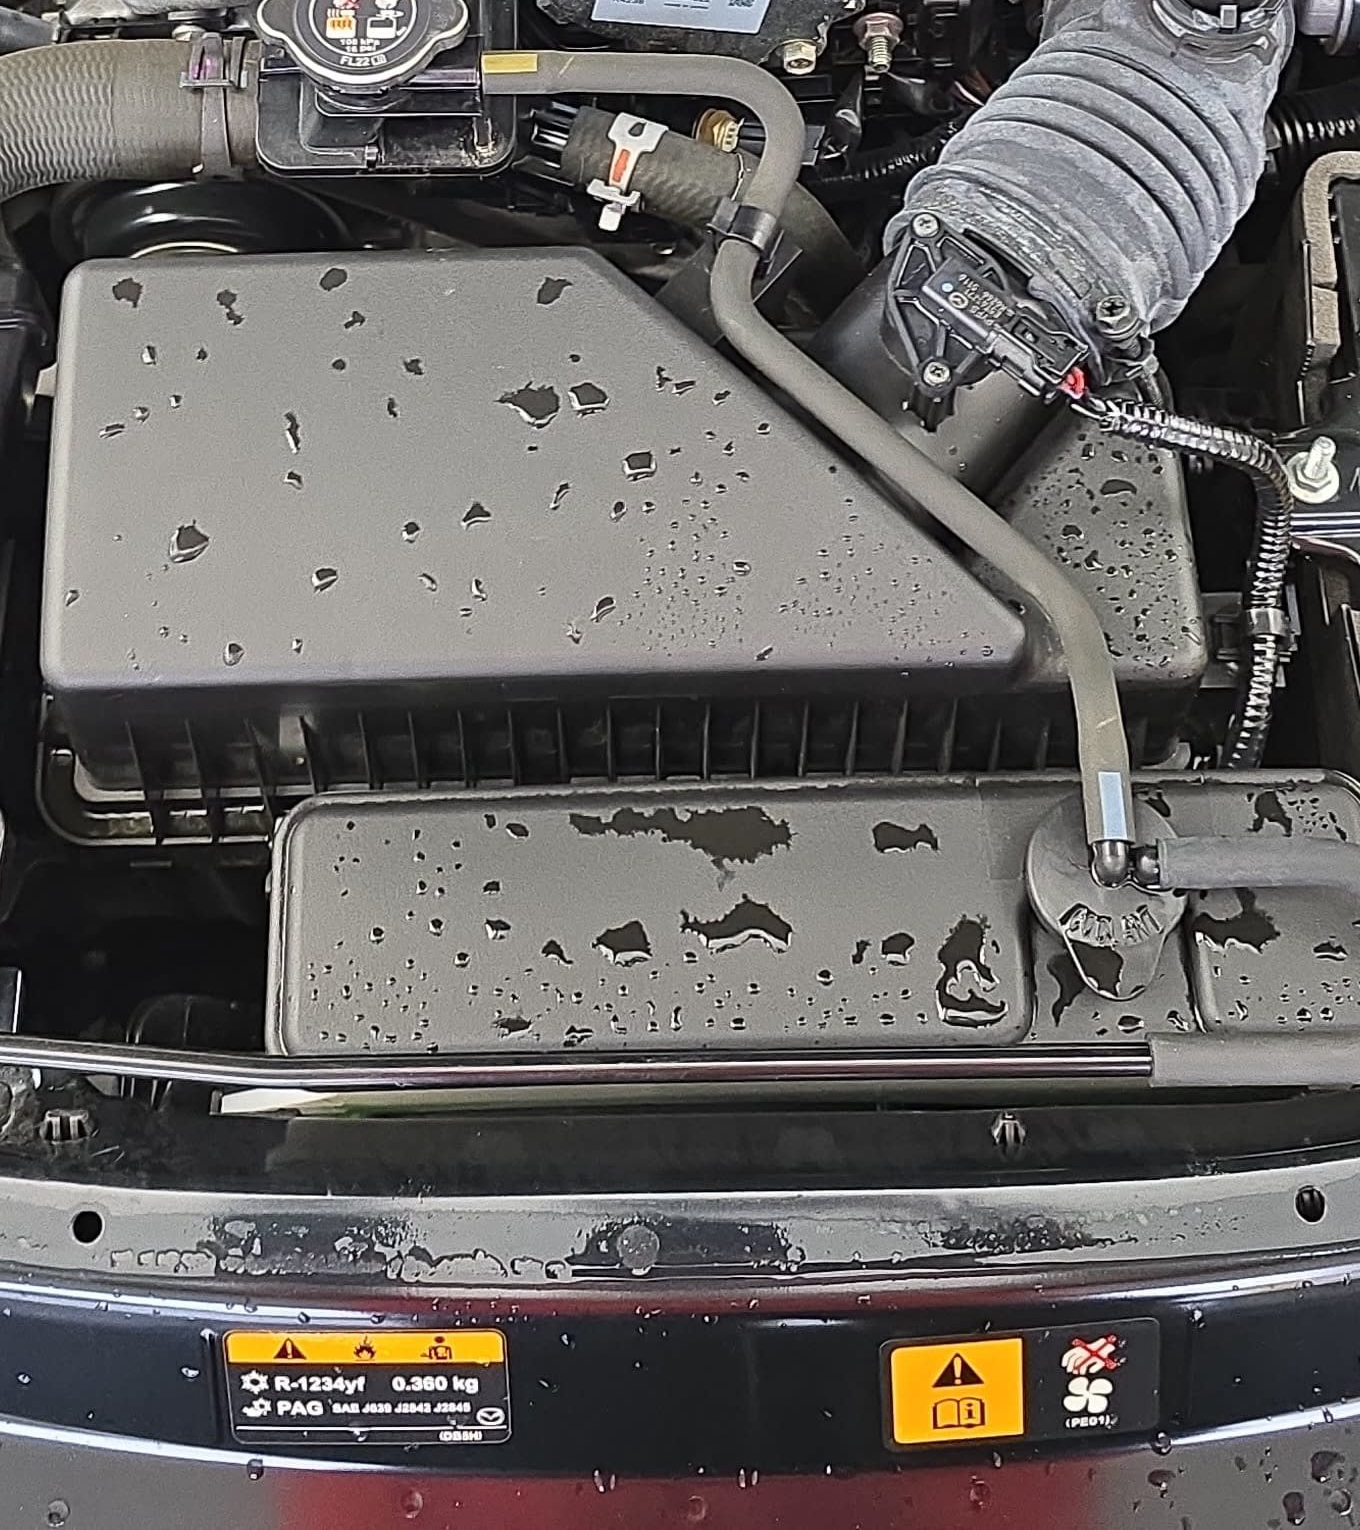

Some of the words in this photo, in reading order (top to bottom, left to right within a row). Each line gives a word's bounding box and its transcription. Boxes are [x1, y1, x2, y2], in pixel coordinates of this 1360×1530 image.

[274, 1375, 367, 1394] R-1234yf
[391, 1375, 448, 1392] 0.360
[453, 1376, 479, 1395] kg
[276, 1400, 324, 1416] PAG
